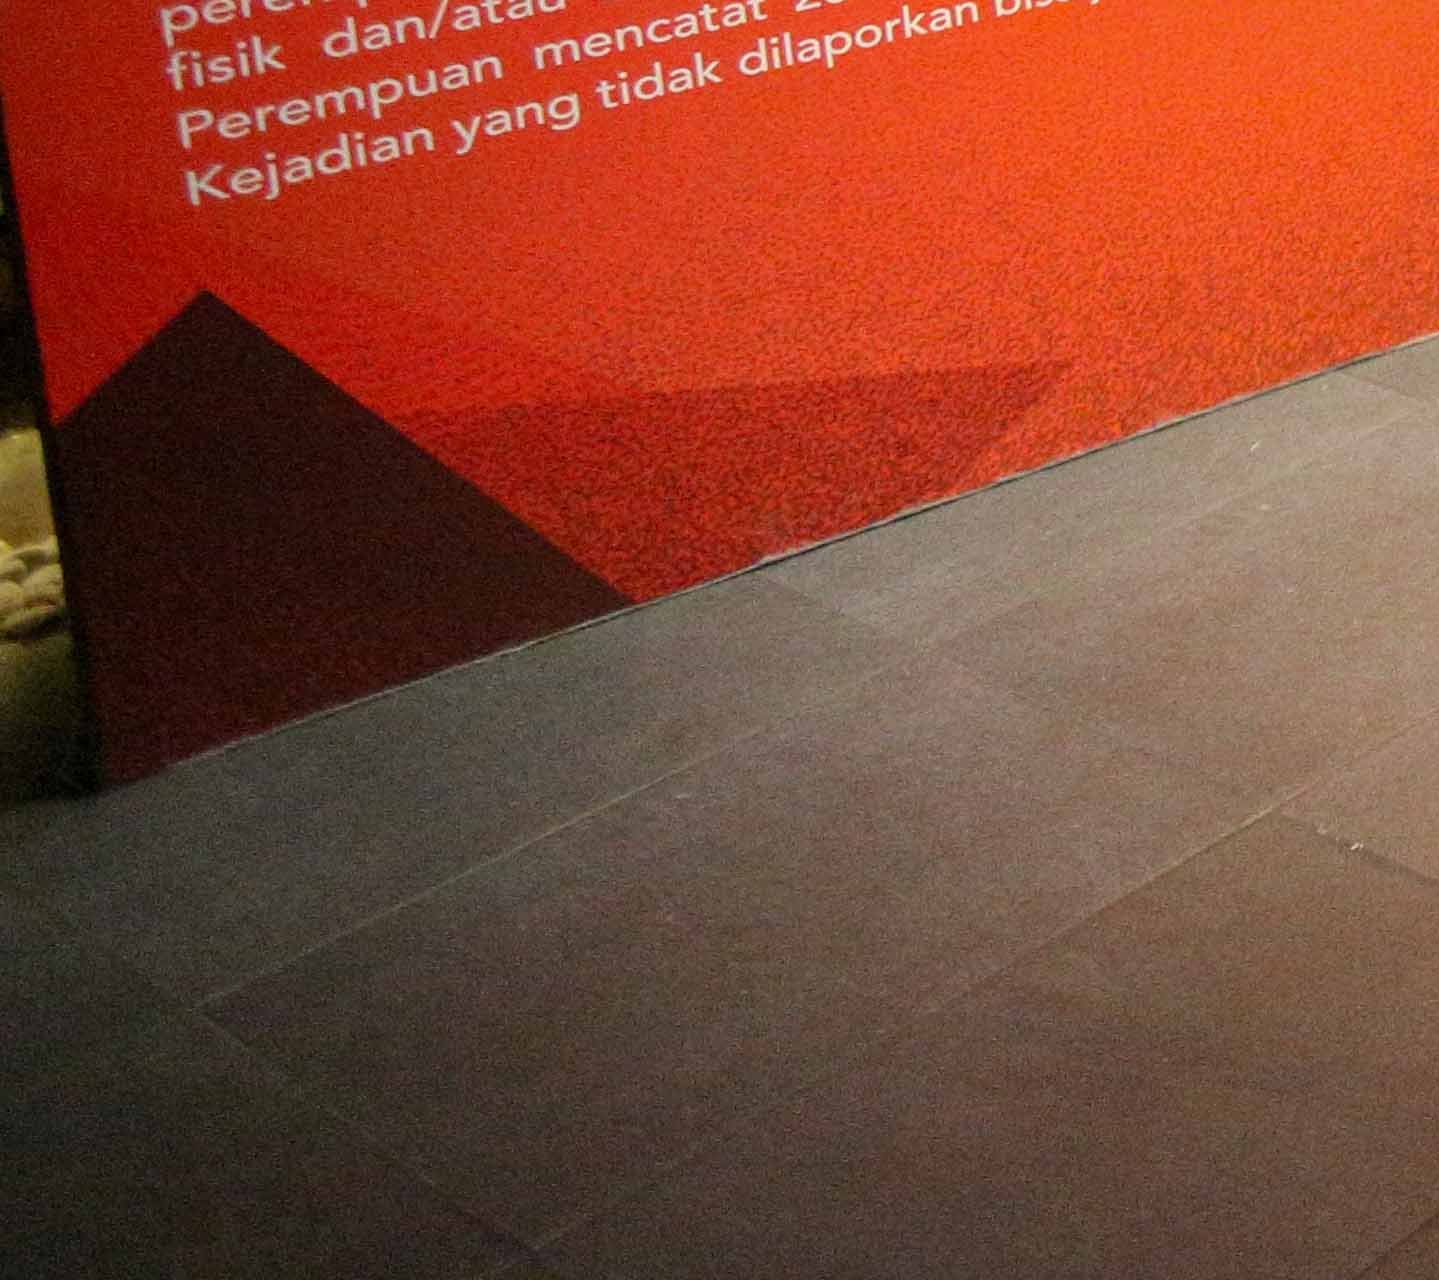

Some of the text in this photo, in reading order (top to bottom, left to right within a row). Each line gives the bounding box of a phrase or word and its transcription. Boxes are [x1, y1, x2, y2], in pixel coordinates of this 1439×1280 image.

[184, 127, 435, 206] Kejadian
[451, 93, 581, 155] yang
[595, 52, 722, 109] tidak
[736, 1, 980, 76] dilaporkan
